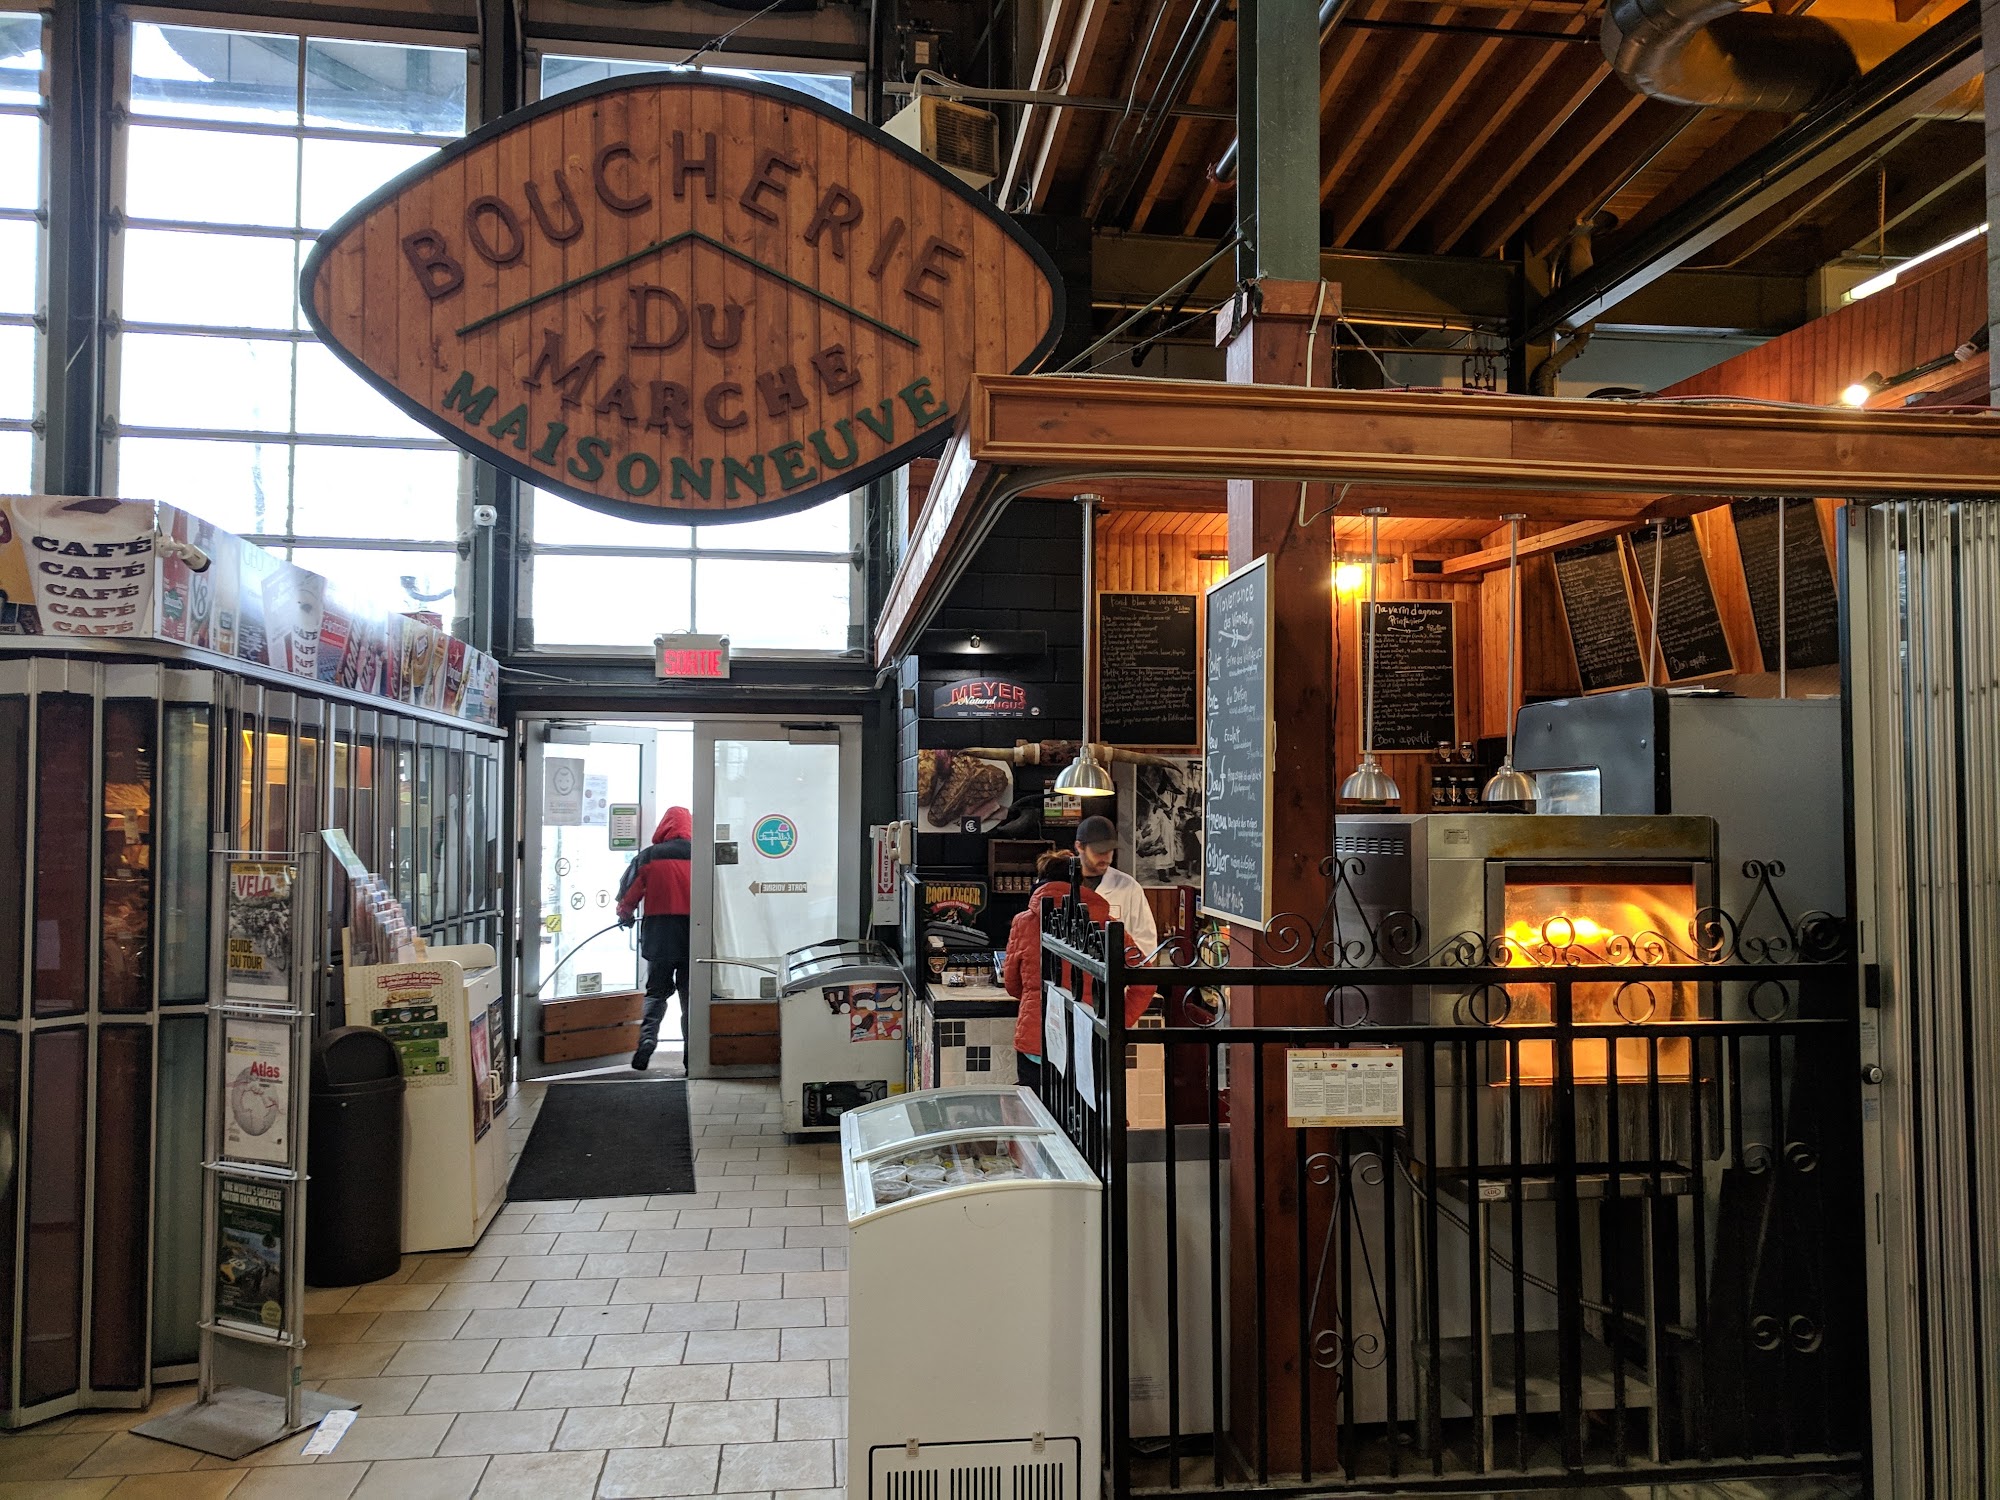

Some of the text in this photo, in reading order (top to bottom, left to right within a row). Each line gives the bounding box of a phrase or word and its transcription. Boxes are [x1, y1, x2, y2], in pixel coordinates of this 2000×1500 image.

[402, 130, 964, 307] BOUCHERIE
[628, 284, 744, 349] DU
[522, 330, 863, 435] MARCHE
[443, 371, 952, 502] MAISONNEUVE
[31, 536, 152, 557] CAFÉ
[40, 561, 146, 580] CAFÉ
[45, 583, 140, 600] CAFÉ
[48, 602, 136, 618] CAFÉ
[52, 620, 134, 635] CAFÉ
[664, 648, 723, 677] SORTIE
[951, 681, 1027, 705] MEYER
[957, 695, 998, 706] Natural
[984, 701, 1025, 711] ANGUS
[1373, 733, 1396, 748] Bon
[1205, 842, 1230, 873] Gibier
[925, 886, 981, 906] BOOTLEGGER
[230, 939, 253, 954] GUIDE
[230, 954, 263, 970] DU TOUR
[250, 1060, 280, 1079] Atlas
